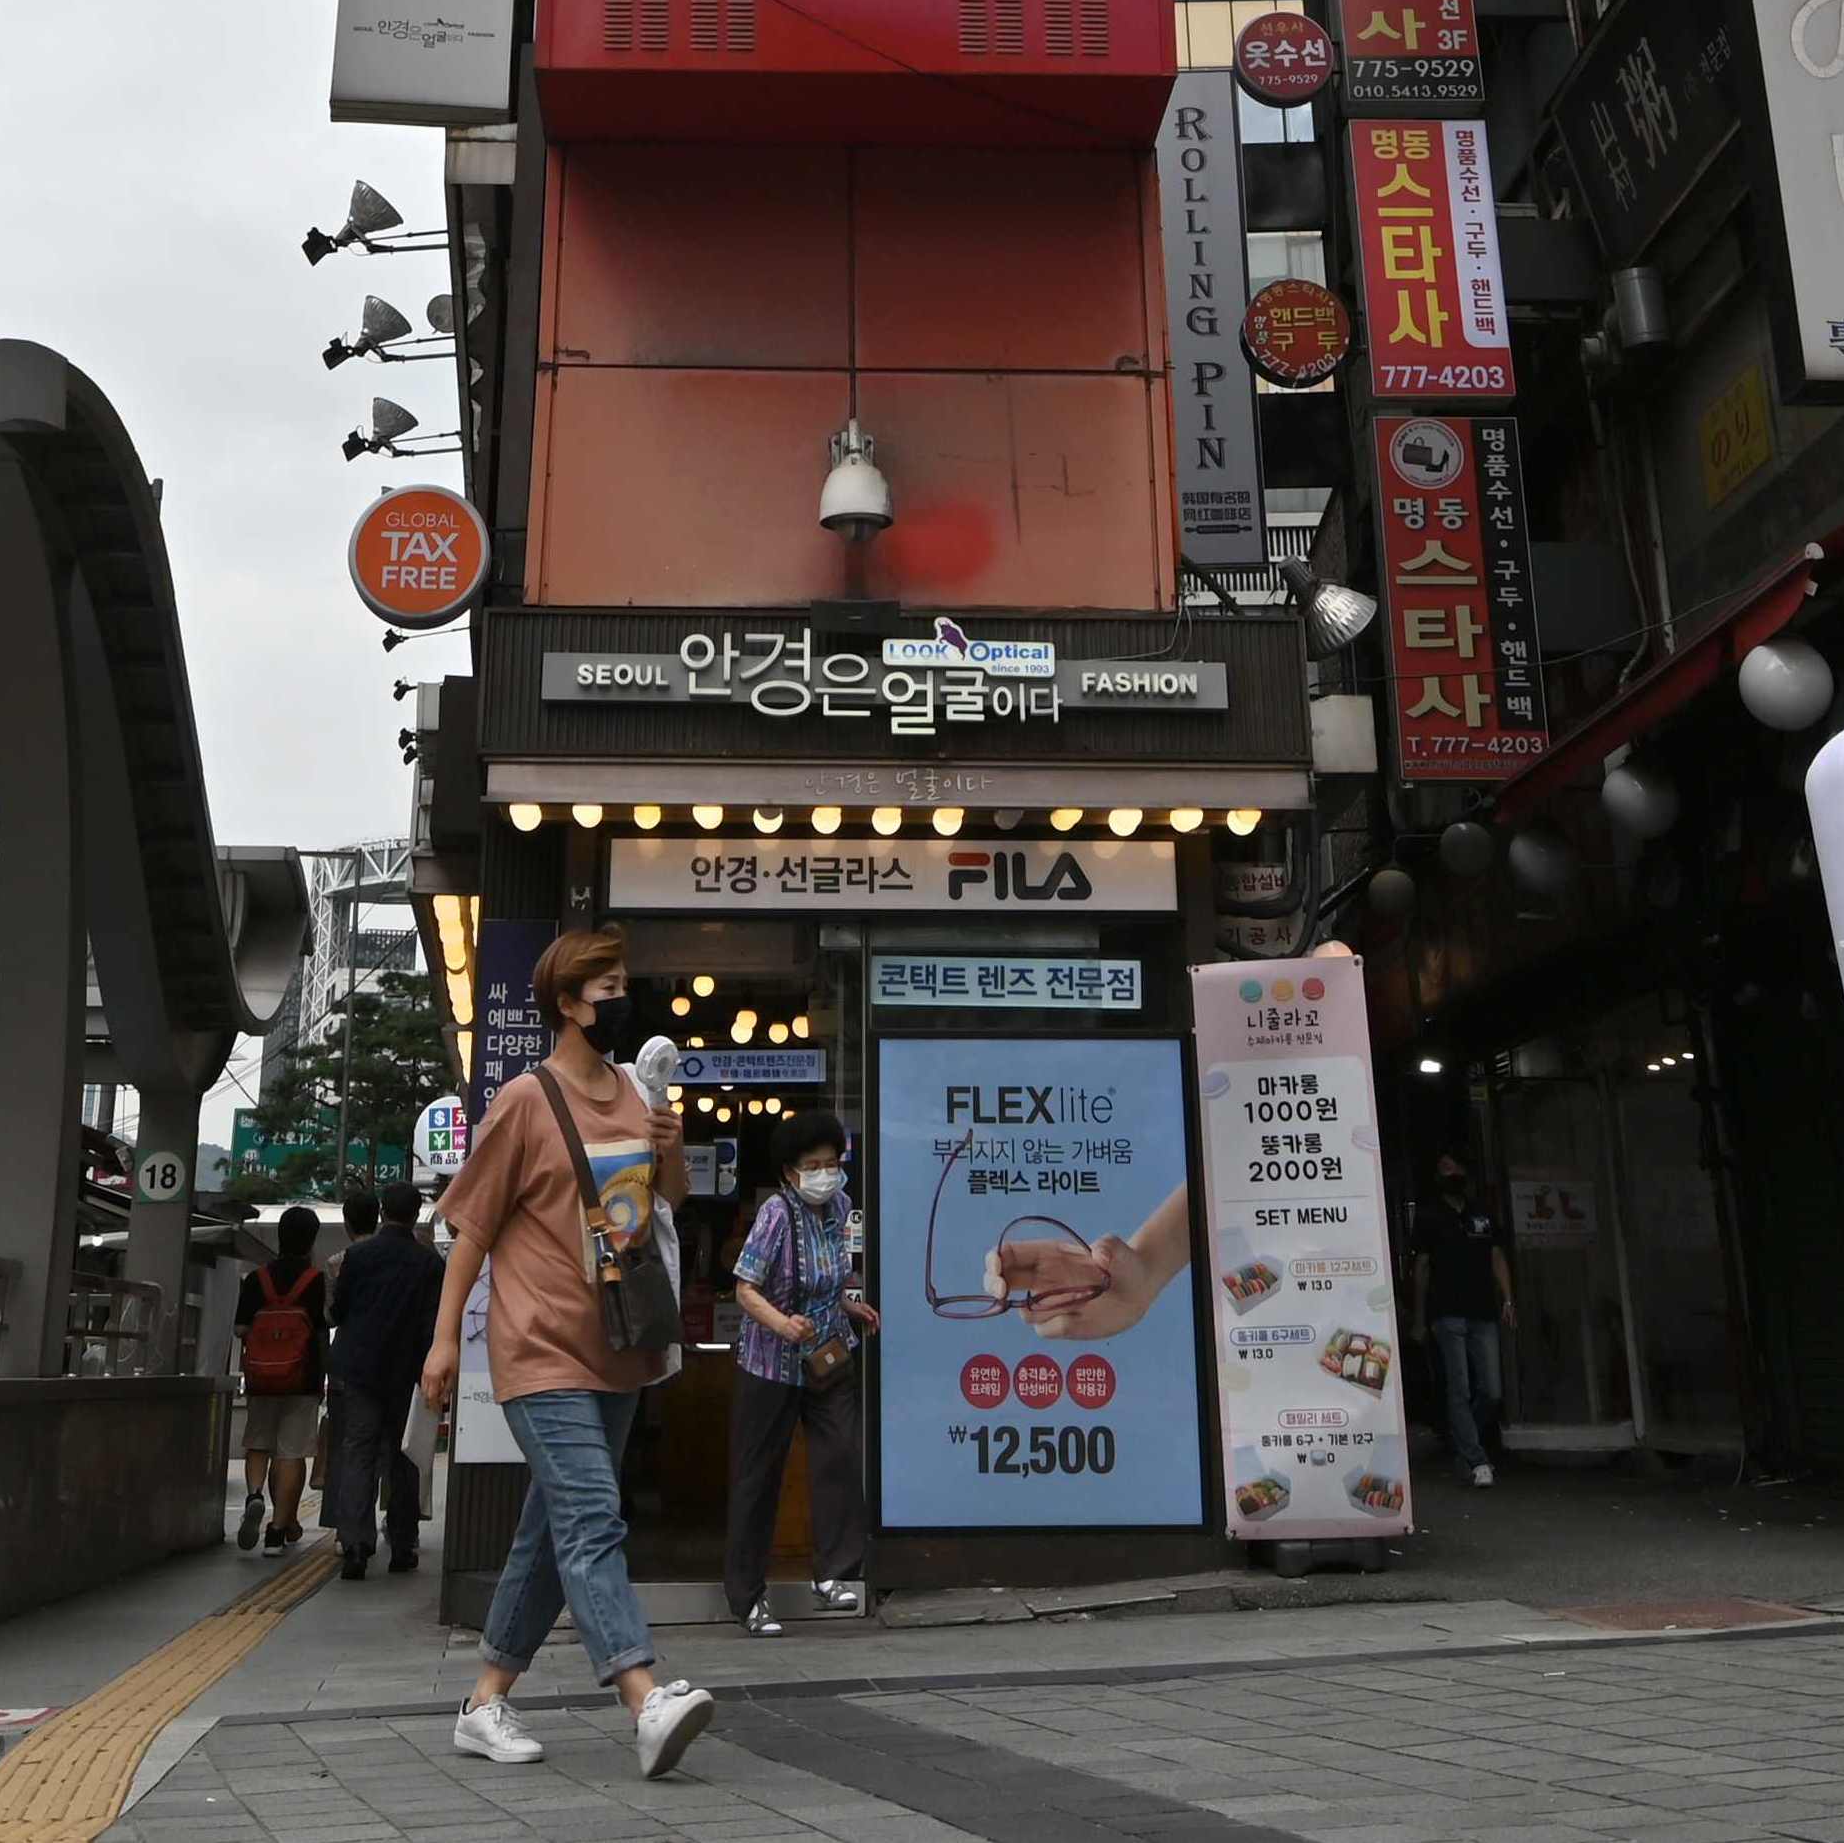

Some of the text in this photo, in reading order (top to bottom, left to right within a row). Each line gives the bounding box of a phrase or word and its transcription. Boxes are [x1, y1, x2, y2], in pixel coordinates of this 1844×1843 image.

[1259, 20, 1305, 38] 선우사
[1436, 28, 1469, 52] 3F
[1243, 39, 1328, 70] 옷수선
[1257, 71, 1319, 89] 775-9529
[1352, 58, 1476, 80] 775-9529
[1352, 84, 1479, 102] 010.5413.9529
[1370, 128, 1432, 161] 명동
[1173, 106, 1222, 339] ROLLING
[1375, 162, 1451, 351] 스타사
[1269, 306, 1336, 328] 핸드백
[1381, 365, 1506, 391] 777-4203
[1190, 361, 1227, 472] PIN
[385, 511, 461, 530] GLOBAL
[1392, 495, 1471, 530] 명동
[380, 532, 459, 564] TAX
[380, 565, 457, 591] FREE
[1395, 537, 1491, 730] 스타사
[887, 641, 1051, 663] LOOK Optical
[575, 626, 1199, 736] SEOUL 안경은 얼굴이다 FASHION
[991, 664, 1050, 675] since 1993
[947, 852, 1093, 903] FILA
[876, 961, 1138, 1003] 콘택트 렌즈 전문점
[487, 1007, 543, 1031] 예쁘고
[486, 1033, 543, 1057] 다양한
[1257, 1074, 1322, 1097] 마카롱
[1242, 1097, 1340, 1125] 1000원
[932, 1138, 1133, 1166] 부러지지 않는 가벼움
[1260, 1133, 1324, 1156] 뚱카롱
[144, 1162, 178, 1191] 18
[1248, 1156, 1344, 1184] 2000원
[967, 1170, 1102, 1195] 플렉스 라이트
[1255, 1206, 1348, 1226] SET MENU
[969, 1367, 1002, 1382] 유연한
[1075, 1367, 1108, 1382] 편안한
[969, 1382, 1002, 1397] 프레임
[1017, 1382, 1059, 1397] 탄성바디
[1075, 1382, 1108, 1397] 착용감
